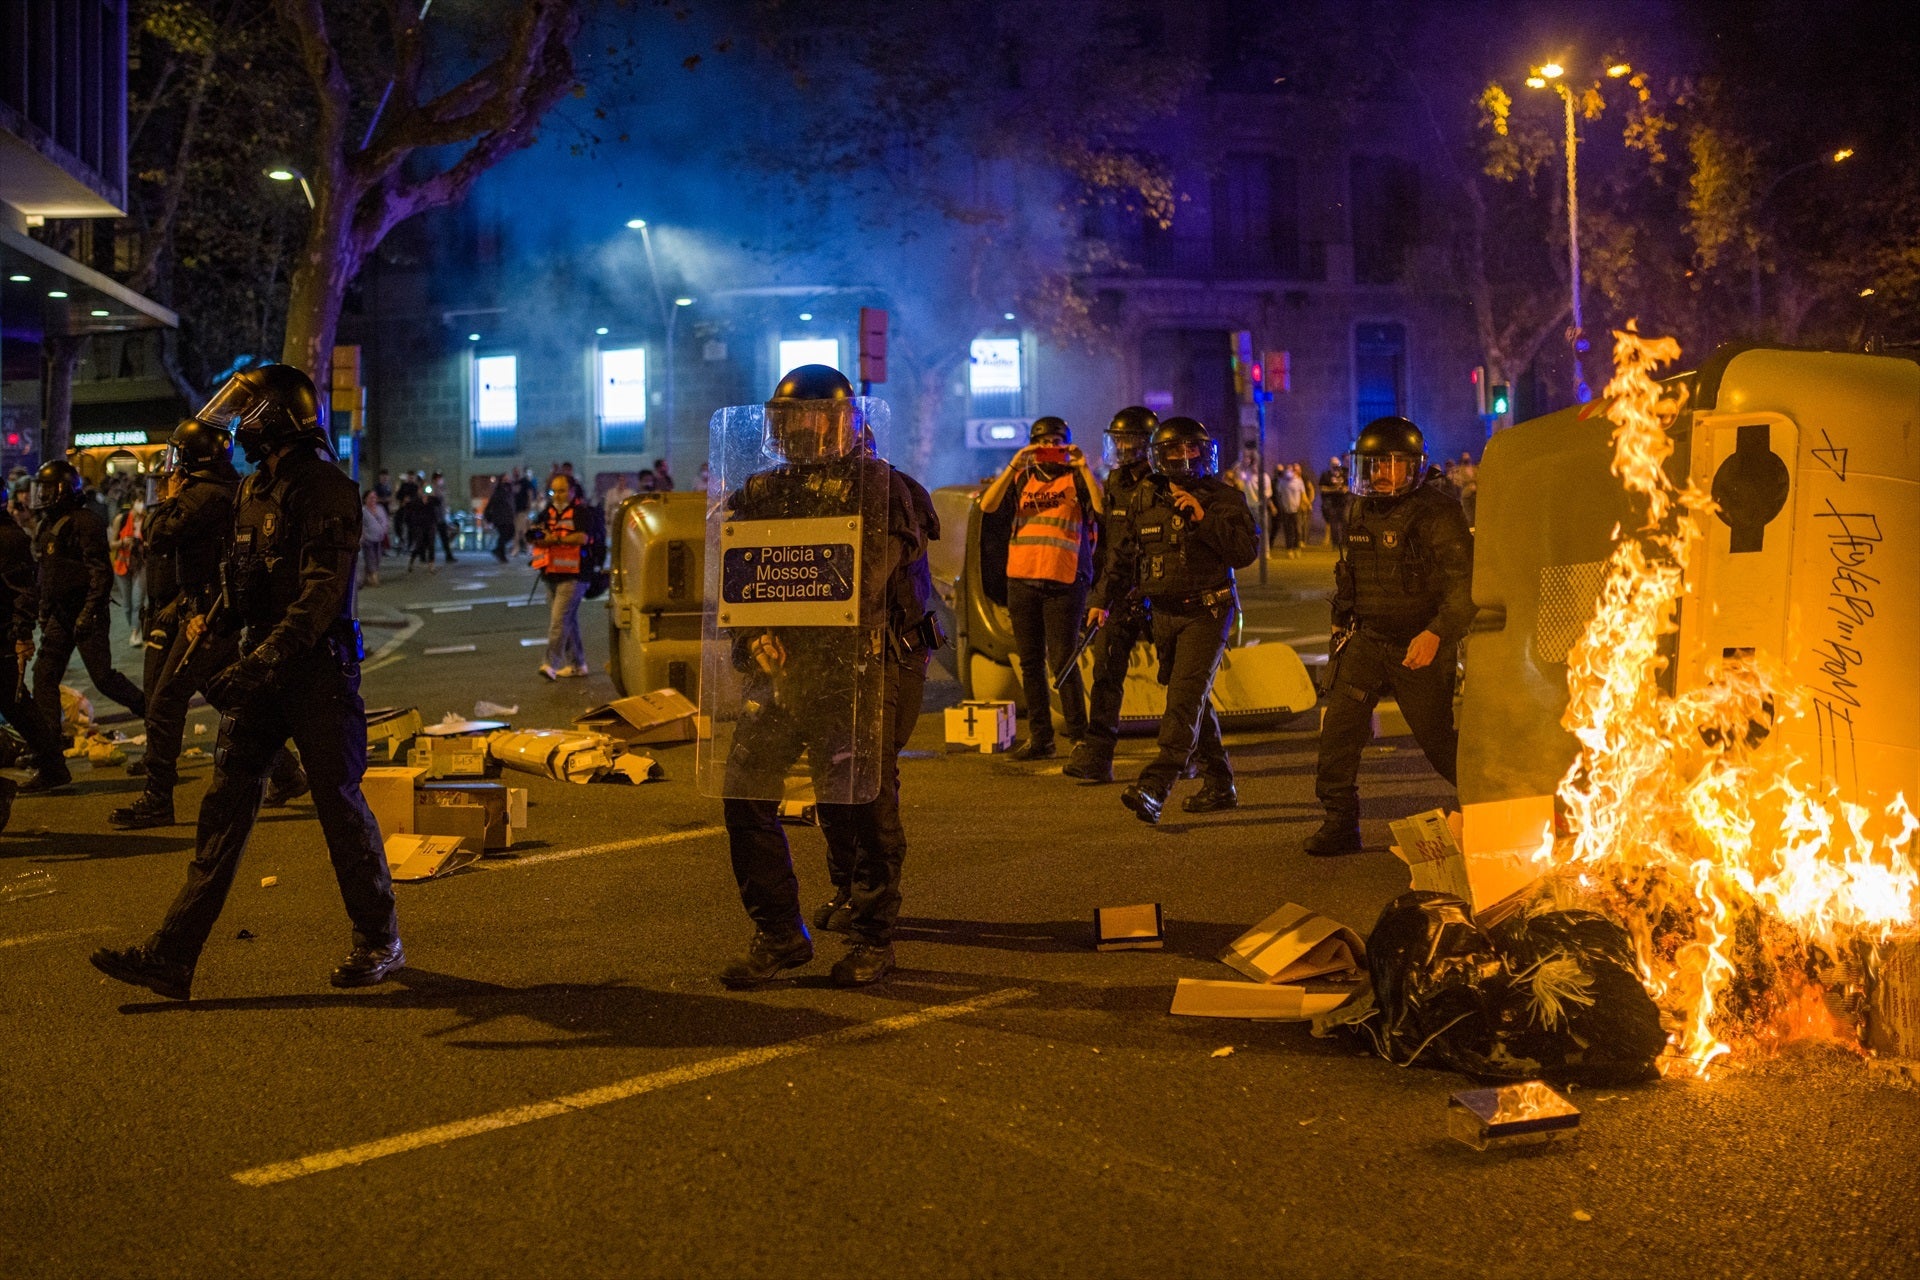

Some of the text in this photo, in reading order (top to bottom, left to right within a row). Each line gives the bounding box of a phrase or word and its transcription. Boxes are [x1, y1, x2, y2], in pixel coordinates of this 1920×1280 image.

[104, 432, 114, 445] DE
[1023, 500, 1060, 510] PRESS
[761, 546, 815, 564] Policia
[756, 565, 819, 581] Mossos
